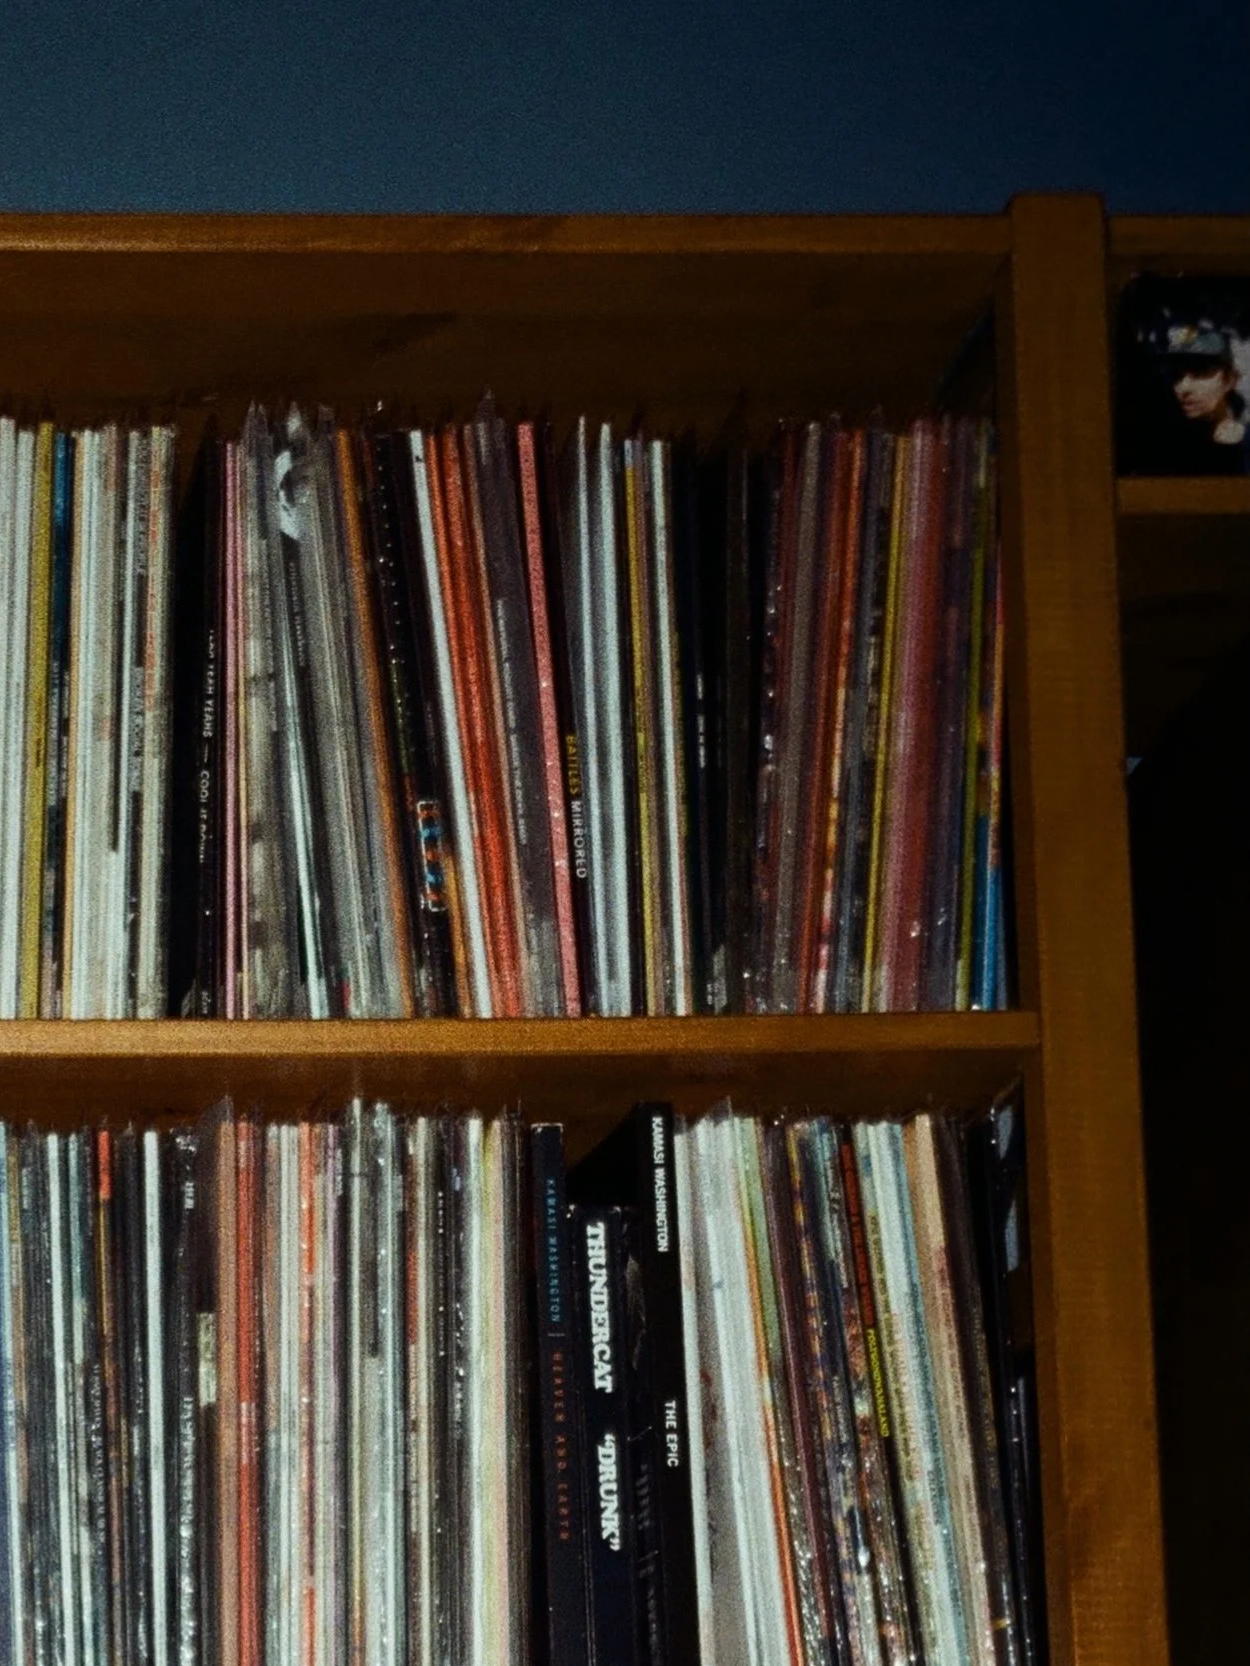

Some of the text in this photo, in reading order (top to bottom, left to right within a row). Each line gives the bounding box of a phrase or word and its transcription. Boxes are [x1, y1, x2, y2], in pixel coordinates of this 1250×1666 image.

[202, 699, 214, 738] YEAHS
[565, 735, 588, 879] BATTLES MIRRORED
[652, 1116, 665, 1164] KAMASI
[654, 1168, 669, 1253] WASHINGTON
[545, 1179, 560, 1322] KAMASI WASHINGTON
[586, 1221, 612, 1393] THUNDERCAT
[551, 1352, 565, 1422] HEAVEN
[664, 1400, 676, 1429] THE
[665, 1433, 678, 1468] EPIC
[557, 1482, 570, 1541] EARTH
